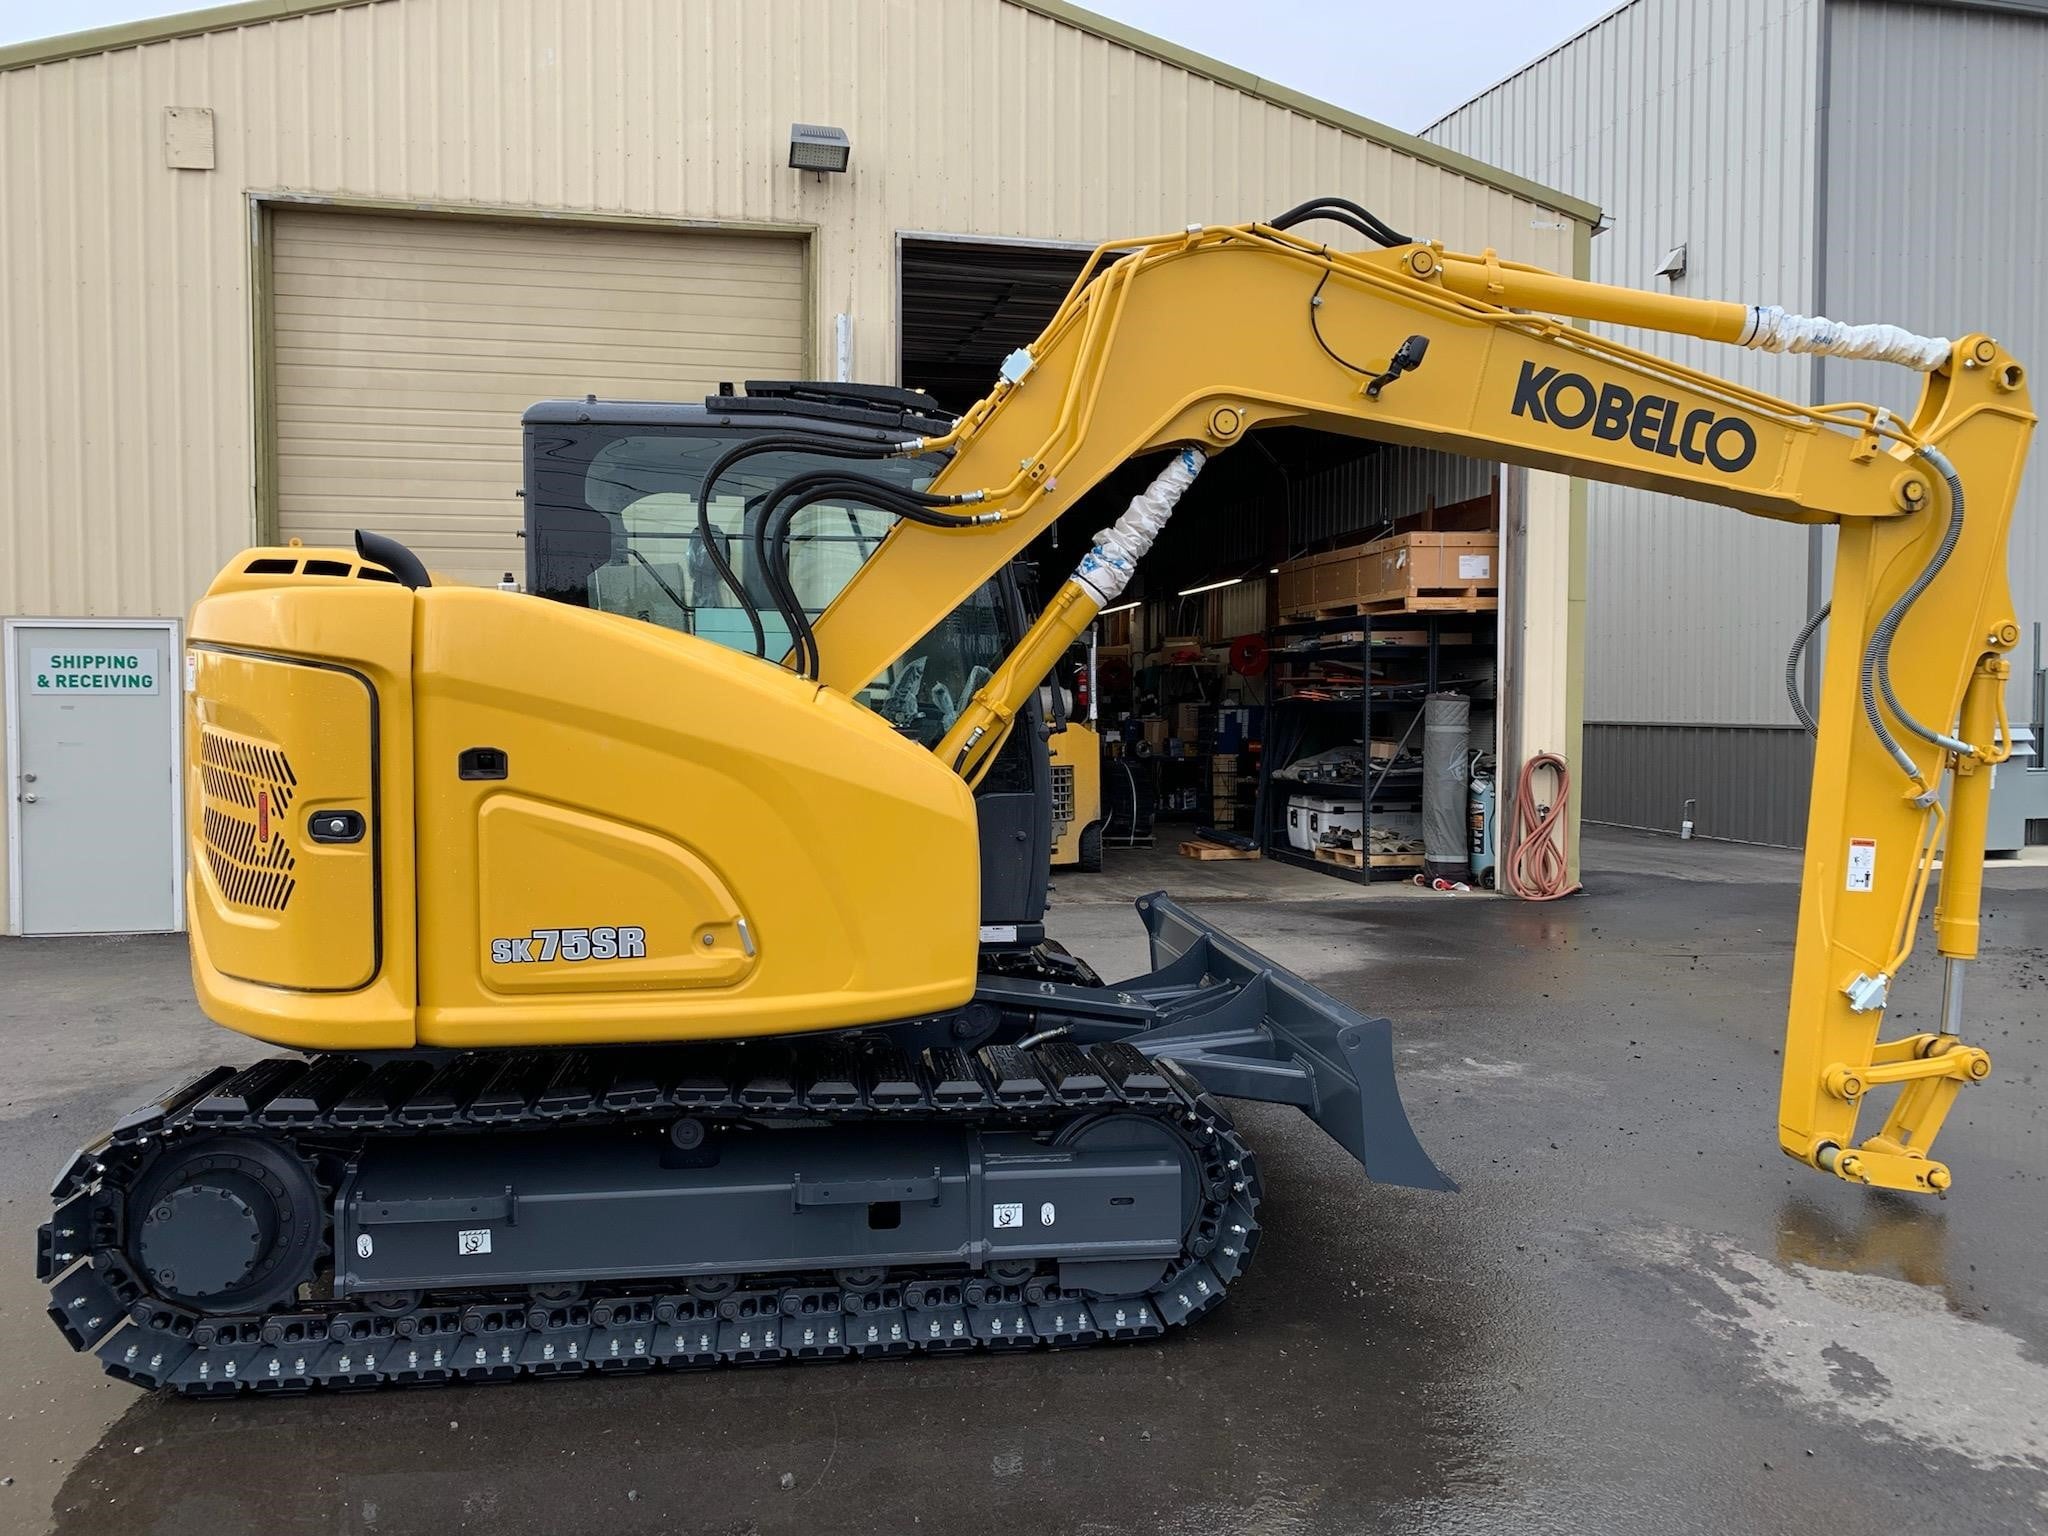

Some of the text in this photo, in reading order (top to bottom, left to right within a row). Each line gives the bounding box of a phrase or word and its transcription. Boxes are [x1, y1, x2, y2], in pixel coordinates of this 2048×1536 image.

[1511, 360, 1757, 473] KOBELCO
[50, 655, 139, 669] SHIPPING
[37, 674, 153, 688] & RECEIVING
